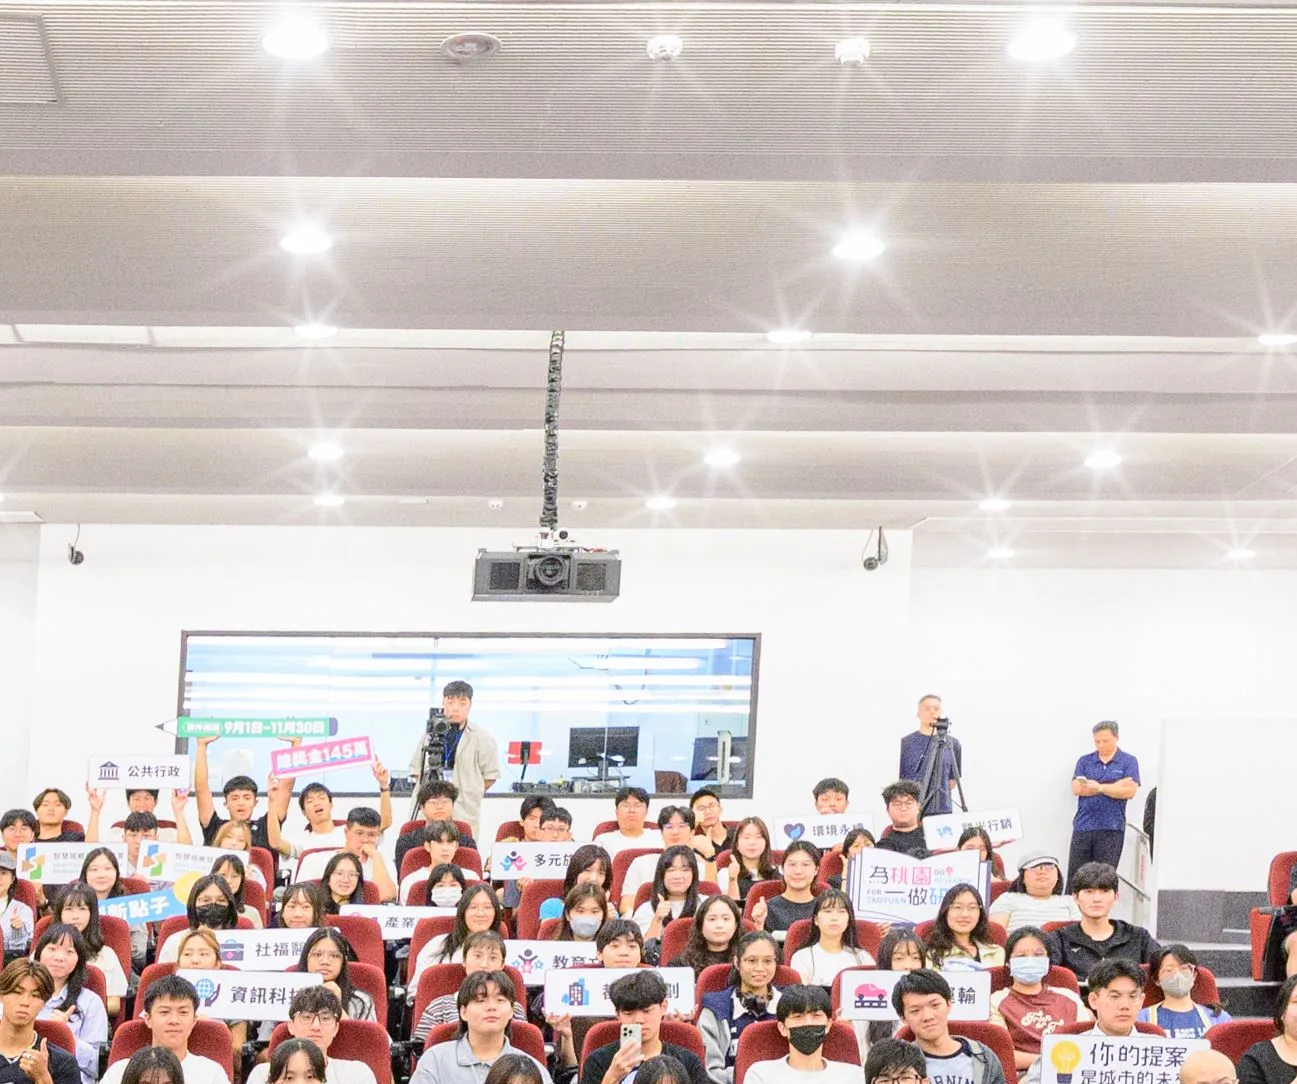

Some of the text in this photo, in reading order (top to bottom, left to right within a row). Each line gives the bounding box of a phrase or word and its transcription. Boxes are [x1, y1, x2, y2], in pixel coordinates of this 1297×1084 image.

[128, 764, 180, 778] 公共行政
[869, 865, 932, 885] 為桃園
[100, 894, 170, 920] 新點子
[384, 916, 415, 928] 產業
[255, 941, 306, 958] 社福醫
[1090, 1041, 1187, 1067] 你的提案
